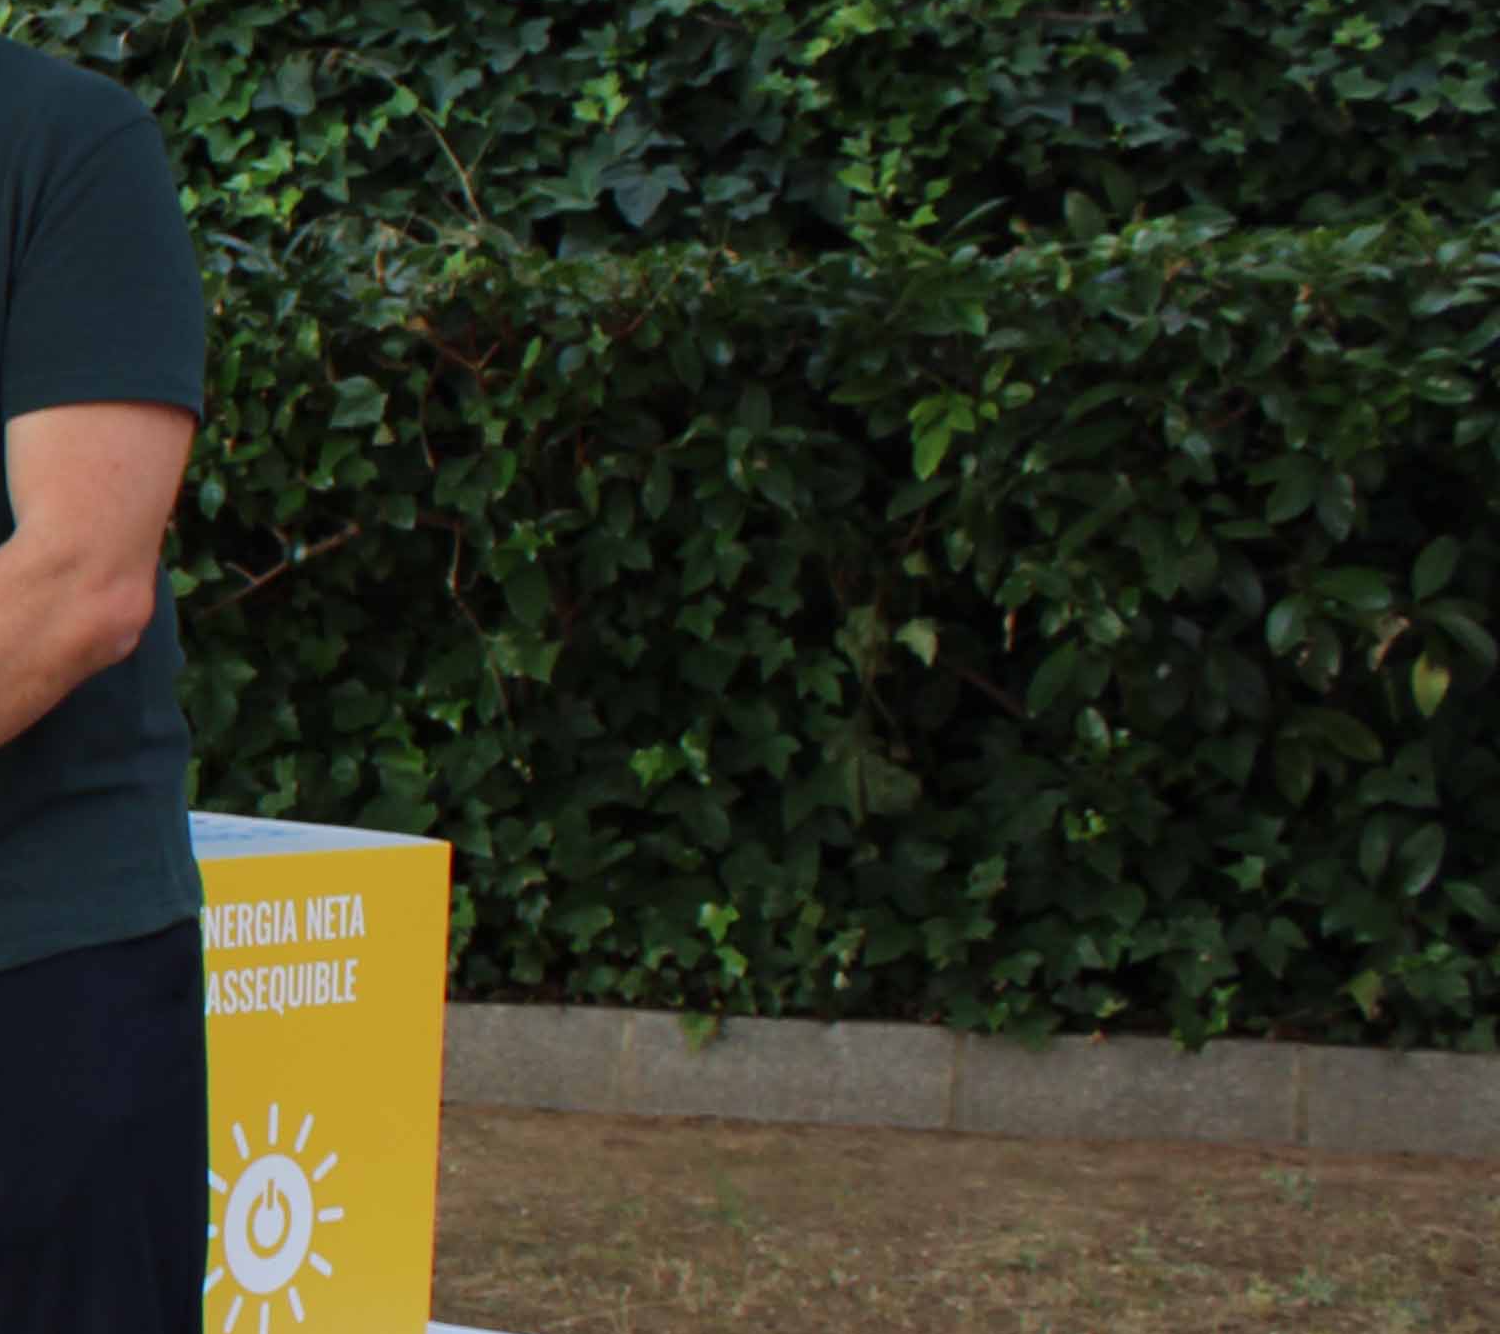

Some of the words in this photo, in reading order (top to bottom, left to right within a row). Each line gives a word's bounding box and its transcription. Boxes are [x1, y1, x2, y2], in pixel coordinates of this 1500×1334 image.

[201, 898, 299, 950] NERGIA
[306, 893, 366, 941] NETA
[205, 958, 360, 1016] ASSEQUIBLE
